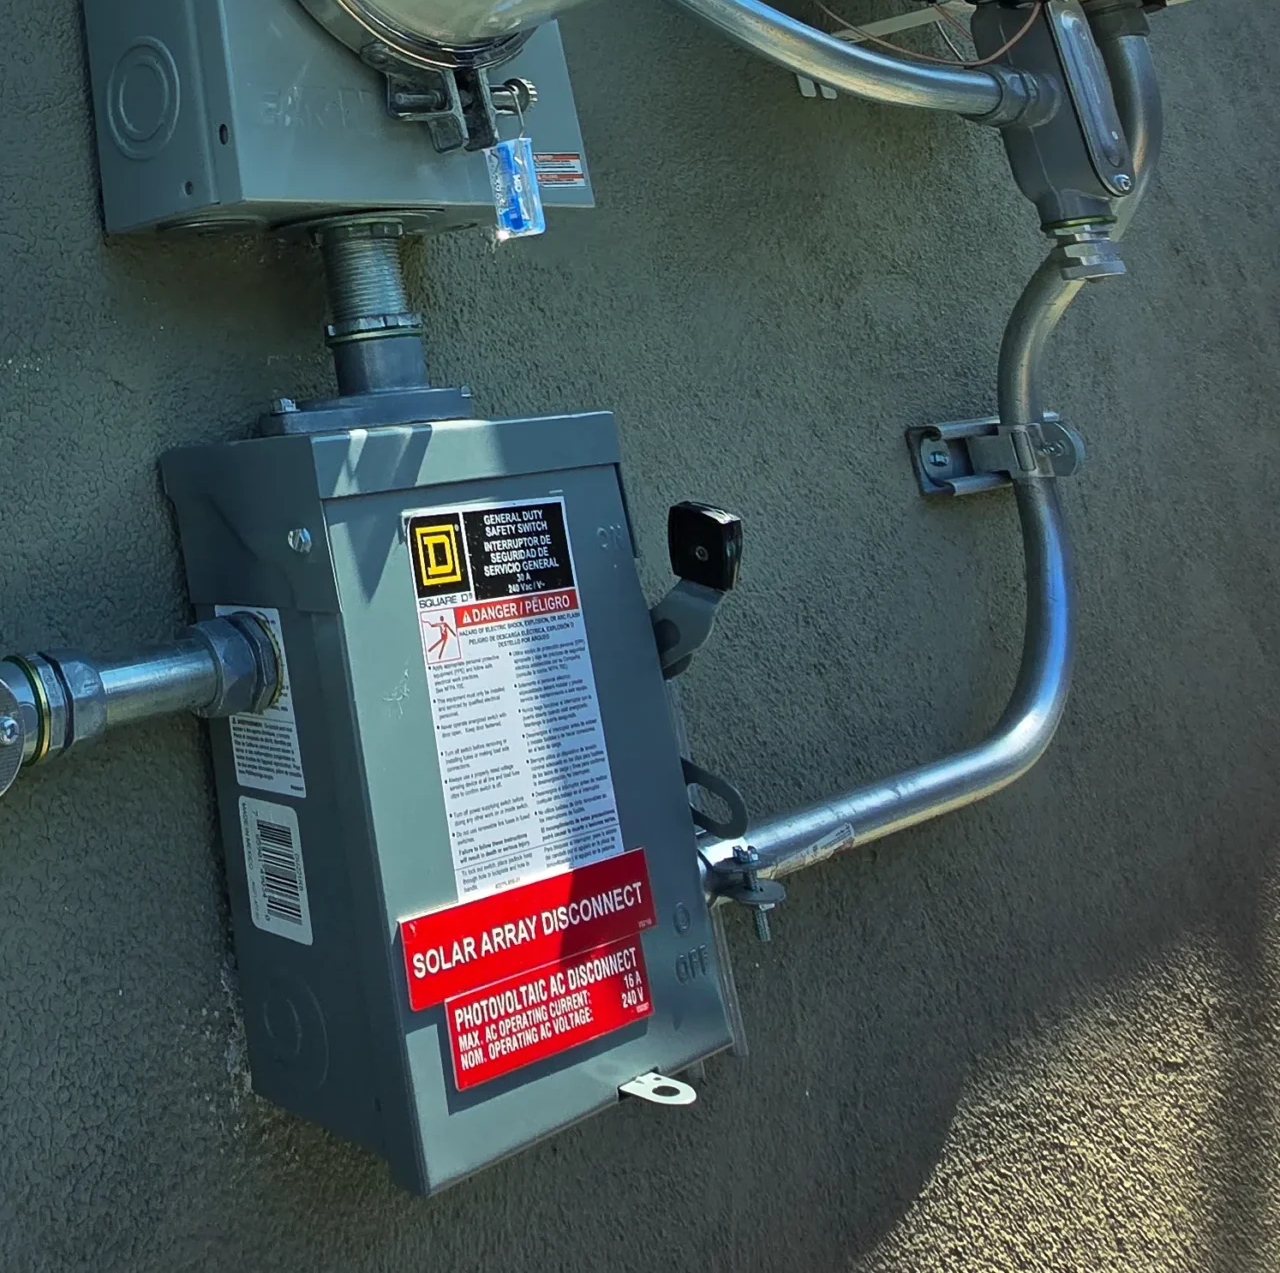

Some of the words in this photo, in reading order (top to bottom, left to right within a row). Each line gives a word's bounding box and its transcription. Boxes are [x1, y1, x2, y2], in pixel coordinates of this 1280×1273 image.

[483, 512, 522, 526] GENERAL
[522, 510, 543, 522] DUTY
[485, 524, 517, 538] SAFETY
[517, 521, 549, 535] SWITCH
[484, 536, 539, 553] INTERRUPTOR
[490, 549, 537, 564] SEGURIDAD
[484, 563, 522, 577] SERVICIO
[522, 559, 560, 572] GENERAL
[419, 596, 458, 610] SQUARE
[471, 605, 518, 623] DANGER
[525, 595, 572, 614] PELIGRO
[412, 937, 479, 979] SOLAR
[480, 916, 538, 957] ARRAY
[541, 881, 643, 935] DISCONNECT
[455, 978, 548, 1032] PHOTOVOLTAIC
[550, 972, 566, 1001] AC
[567, 947, 637, 991] DISCONNECT
[459, 1031, 484, 1052] MAX.
[485, 1024, 497, 1042] AC
[499, 1005, 548, 1037] OPERATING
[549, 989, 592, 1022] CURRENT:
[624, 974, 634, 990] 16
[460, 1048, 488, 1072] NOM.
[489, 1028, 539, 1060] OPERATING
[540, 1023, 552, 1041] AC
[553, 1008, 593, 1037] VOLTAGE:
[622, 990, 638, 1010] 240
